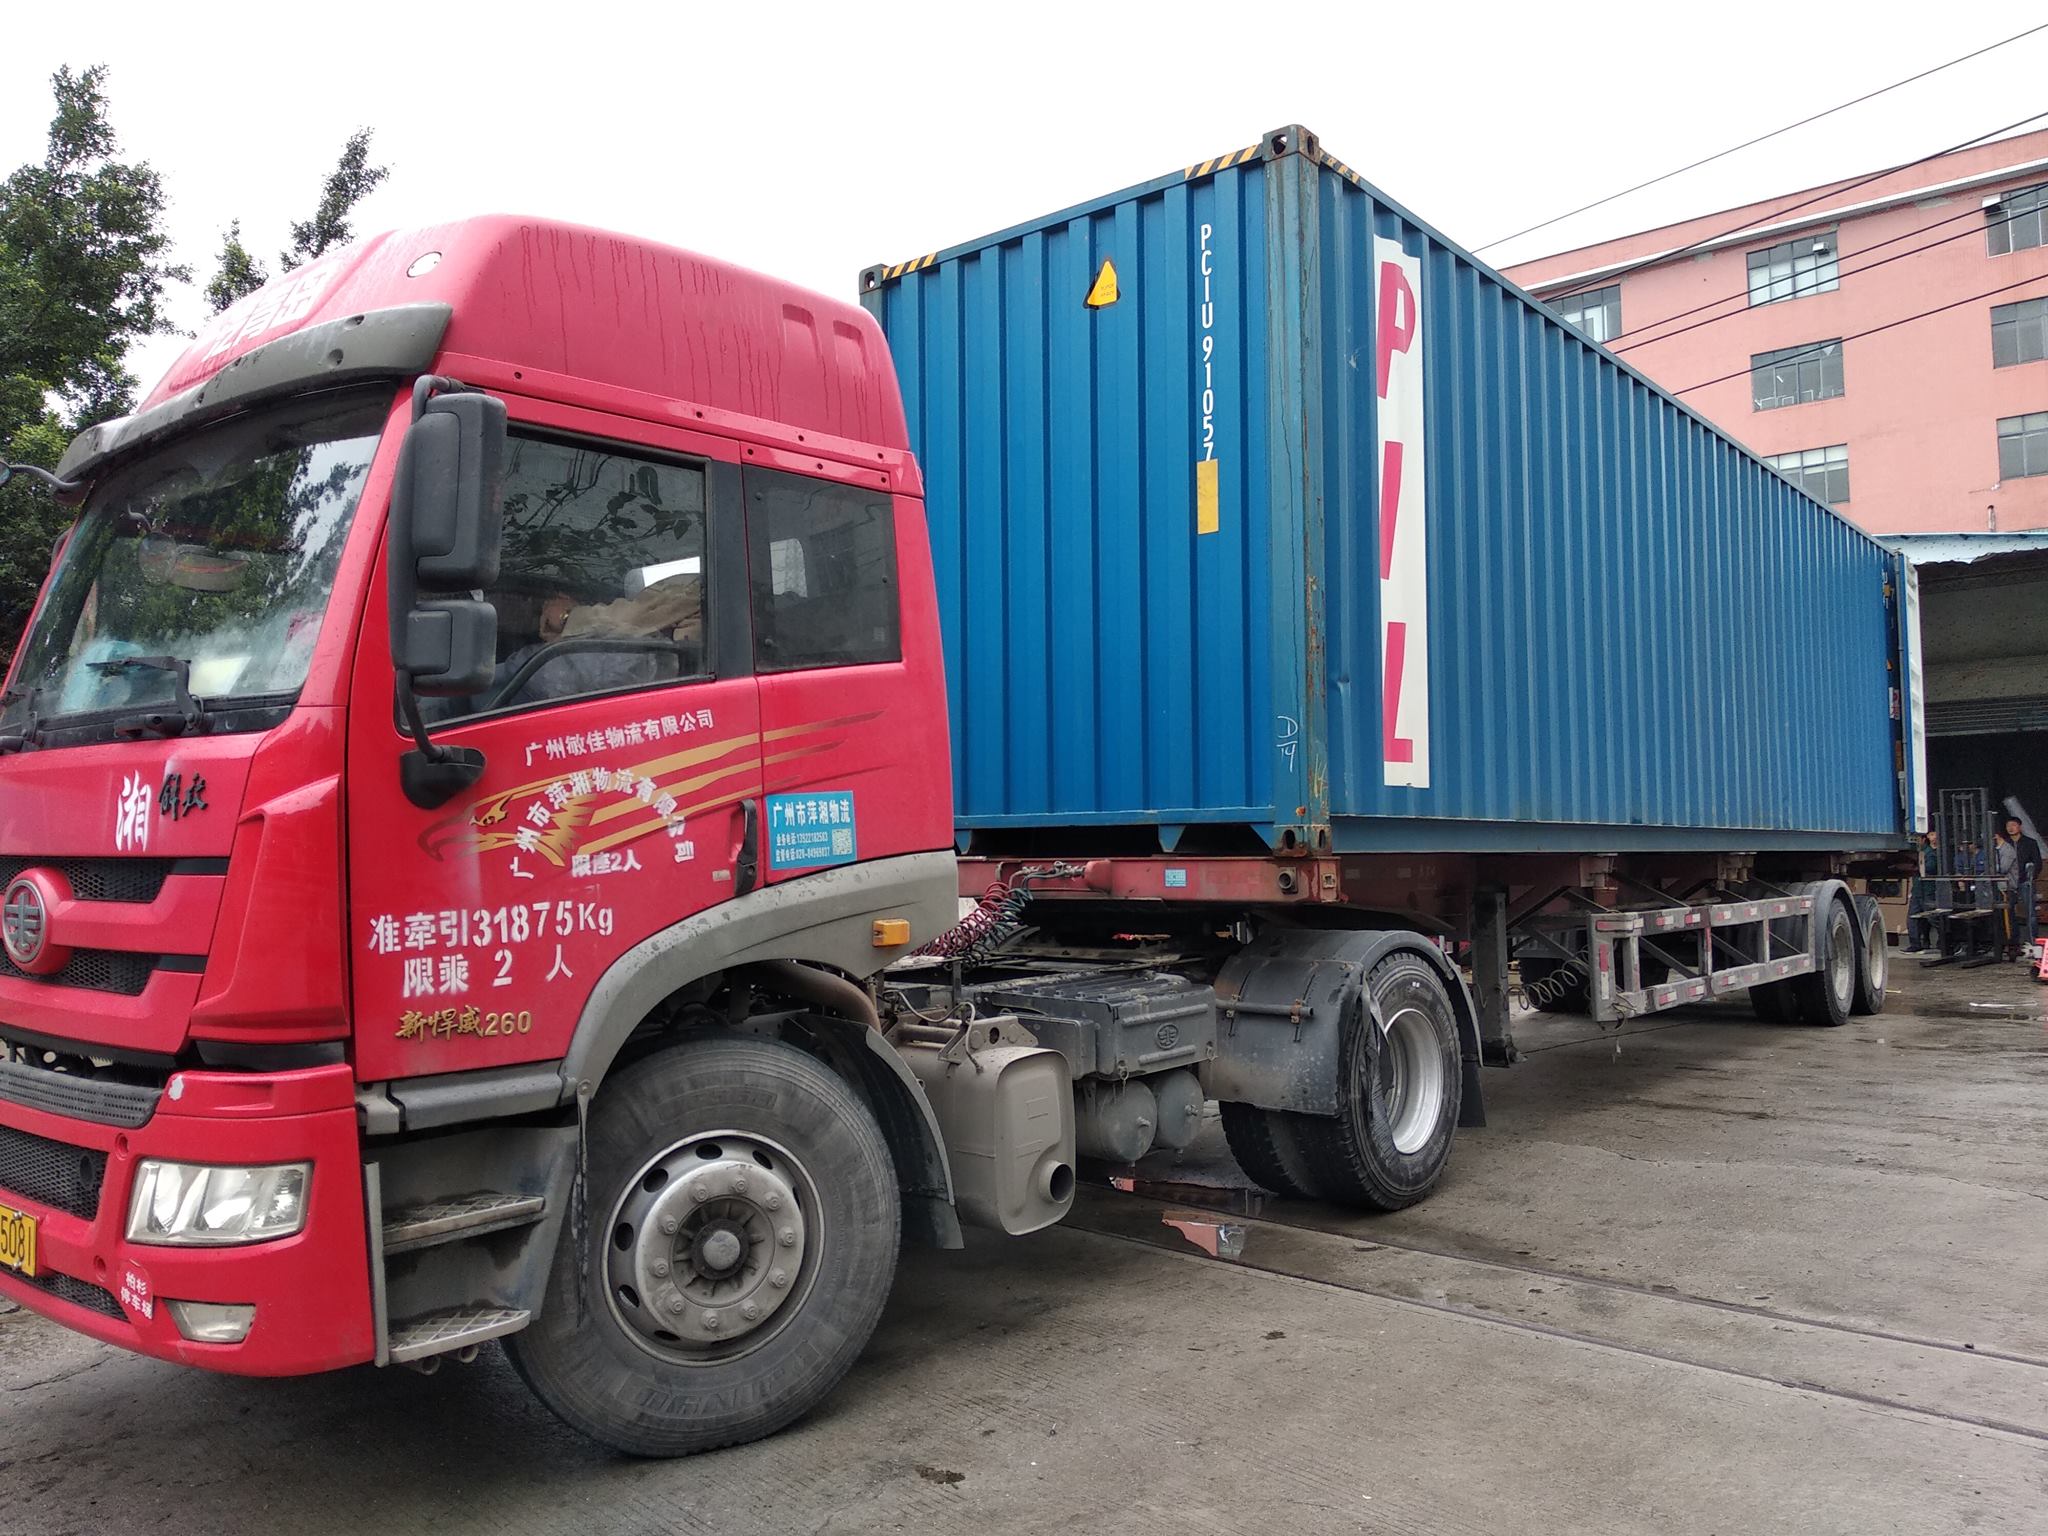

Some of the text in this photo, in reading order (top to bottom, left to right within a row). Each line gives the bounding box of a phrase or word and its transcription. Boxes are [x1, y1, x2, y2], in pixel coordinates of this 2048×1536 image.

[1200, 223, 1214, 329] PCIU
[1377, 261, 1416, 763] PIL
[525, 709, 714, 767] 广州敏佳物流有限公司
[115, 769, 152, 853] 湘
[773, 799, 851, 828] 广州市萍湘物流
